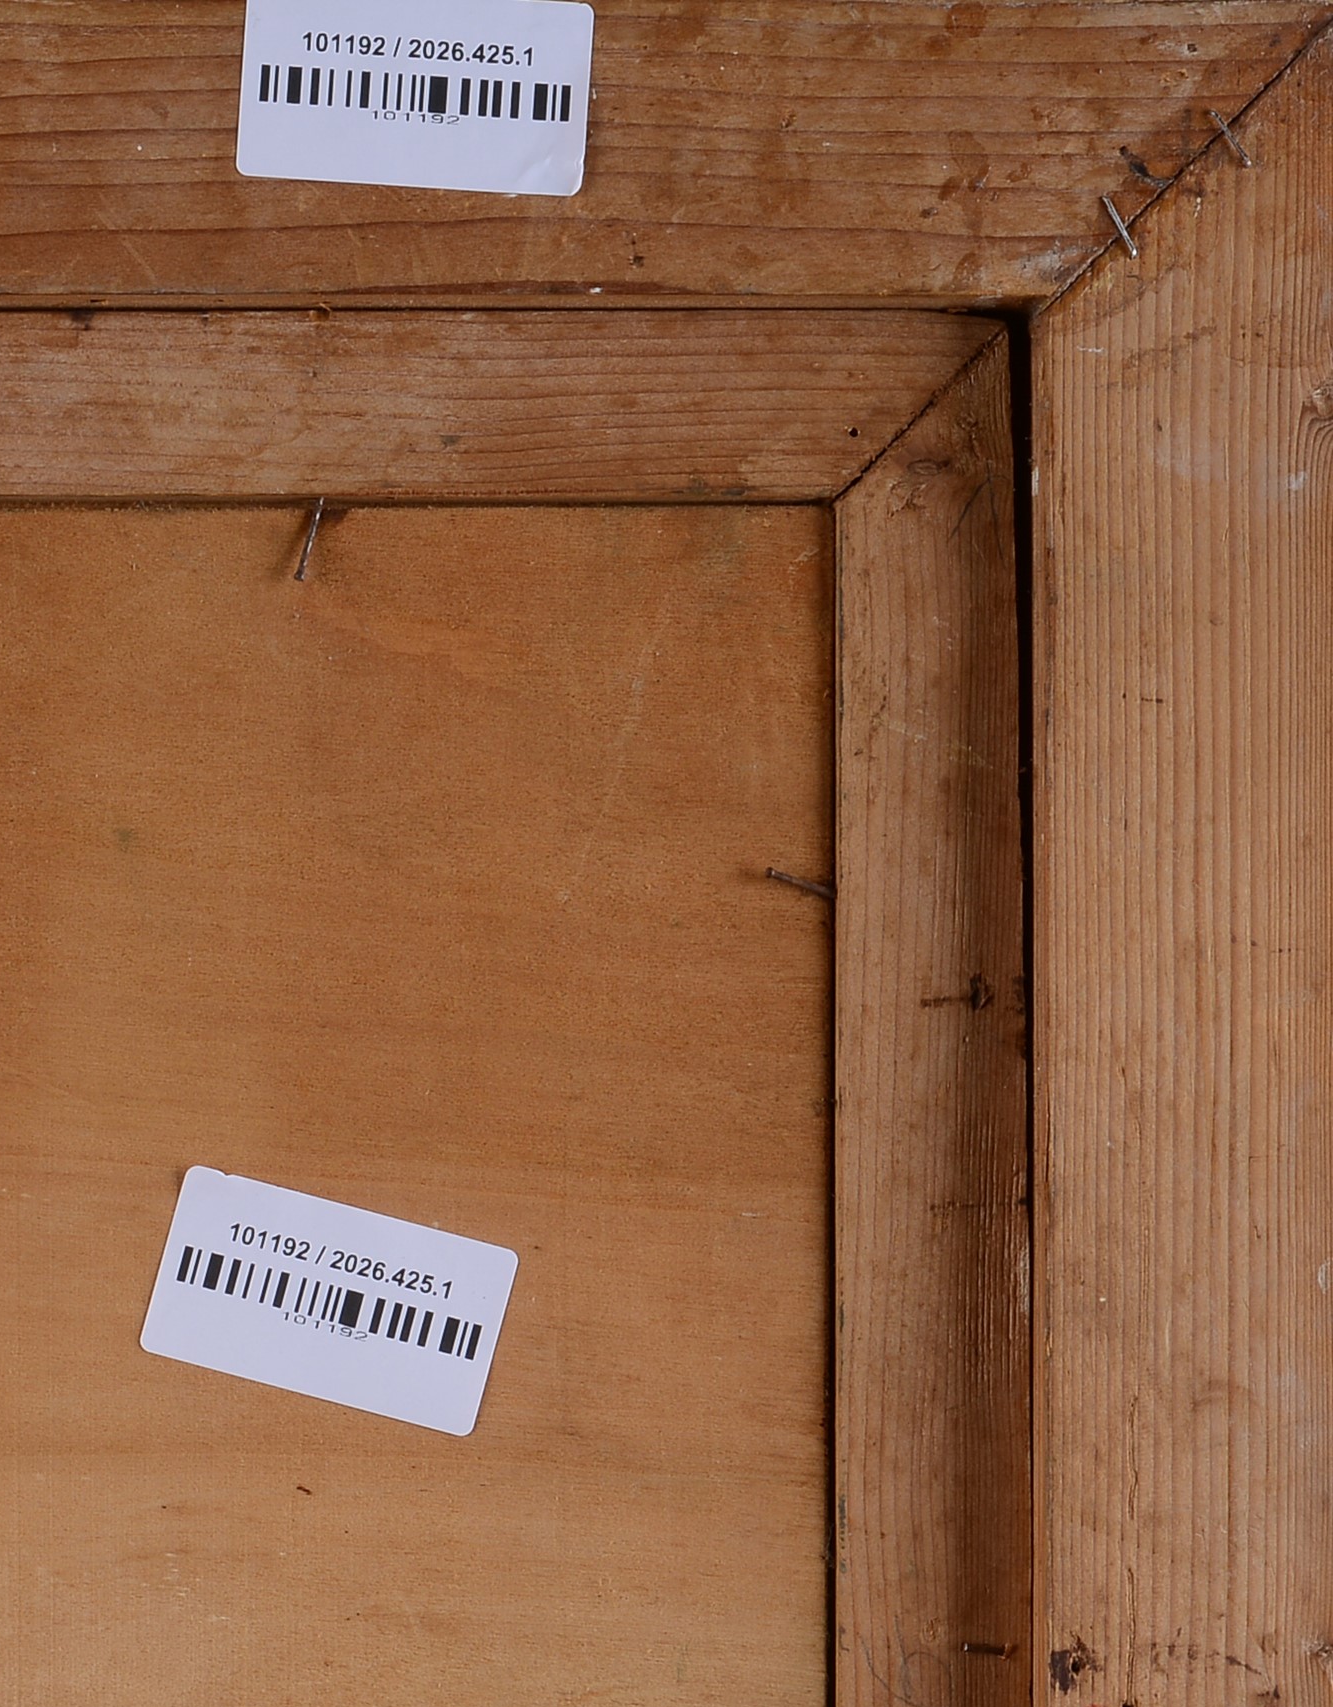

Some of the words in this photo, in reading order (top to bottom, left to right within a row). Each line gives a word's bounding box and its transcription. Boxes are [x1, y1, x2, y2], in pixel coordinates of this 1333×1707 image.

[302, 32, 386, 57] 101192
[393, 36, 402, 58] /
[408, 38, 534, 67] 2026.425.1
[372, 110, 460, 125] 101192
[230, 1223, 311, 1262] 101192
[315, 1246, 327, 1264] /
[330, 1250, 454, 1300] 2026.425.1
[282, 1311, 369, 1343] 101192
